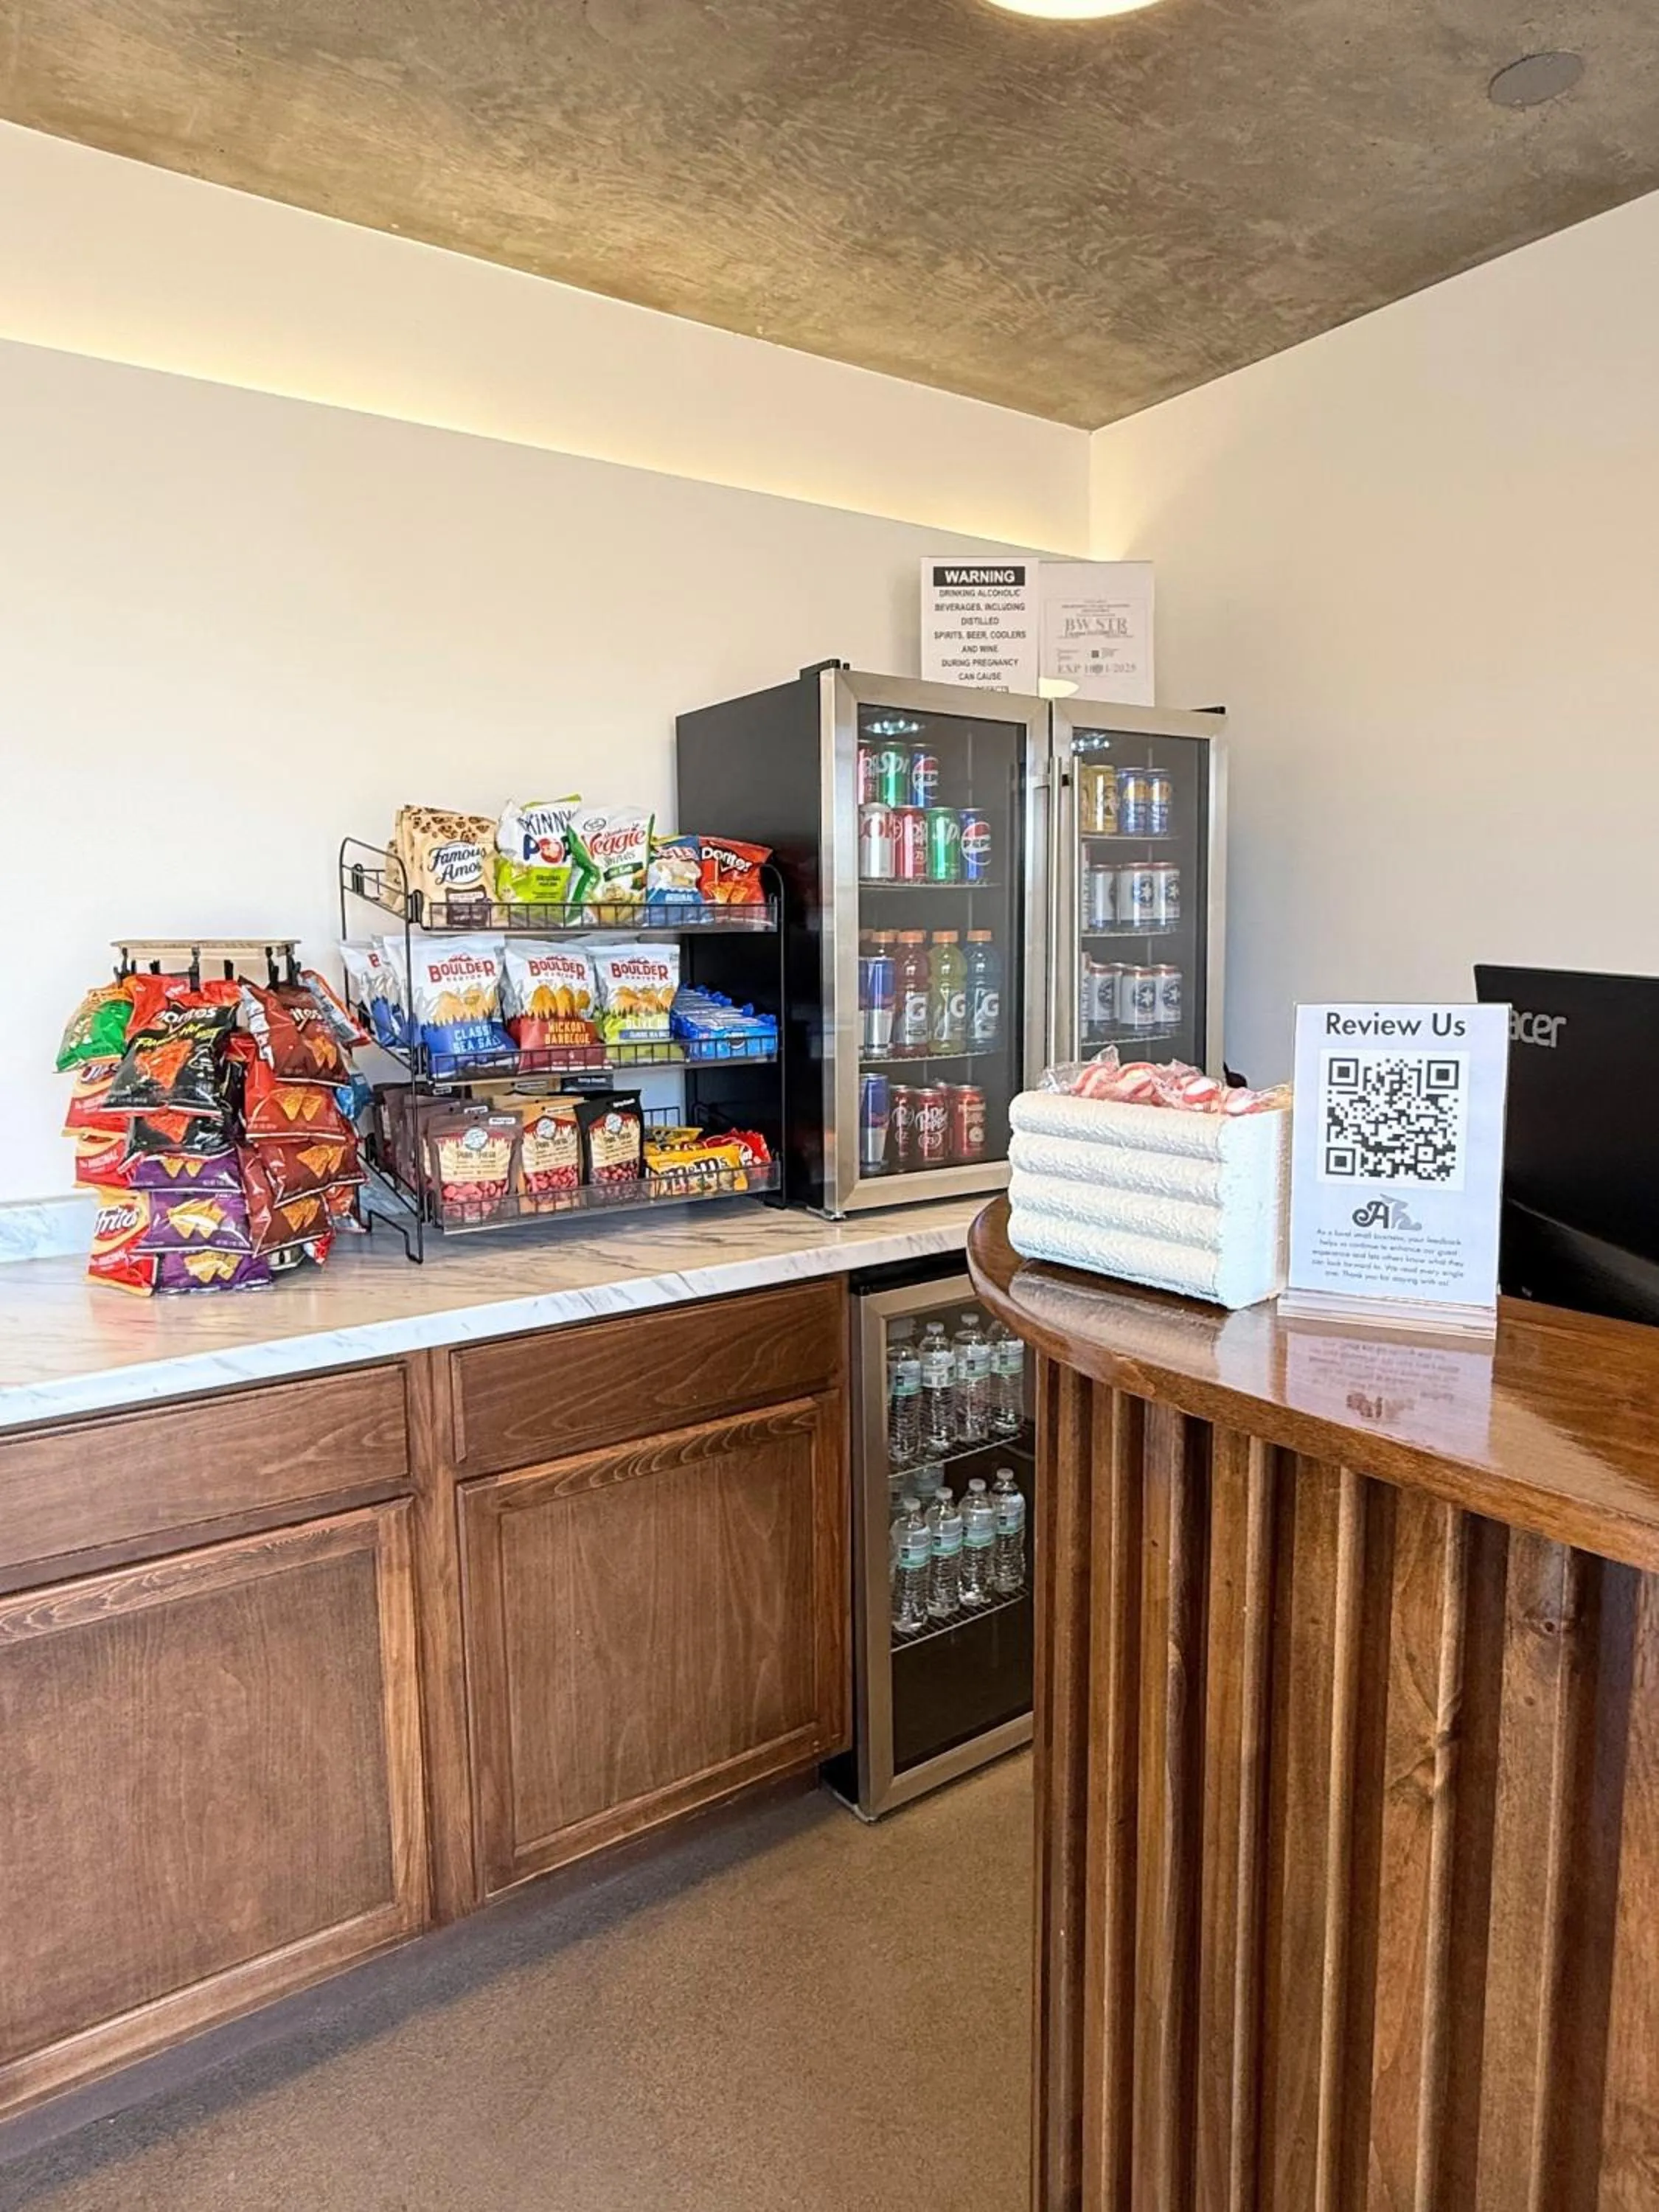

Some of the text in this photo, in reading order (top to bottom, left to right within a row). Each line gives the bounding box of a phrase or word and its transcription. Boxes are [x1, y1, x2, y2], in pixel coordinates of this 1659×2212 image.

[945, 570, 1015, 583] WARNING
[939, 589, 1020, 597] DRINKING ALCOHOLIC
[985, 603, 1026, 611] INCLUDING
[961, 616, 999, 625] DISTILLED
[990, 630, 1026, 639] COOLERS
[942, 658, 1018, 667] DURING PREGNANCY
[959, 672, 1001, 681] CAN CAUSE
[581, 830, 645, 860] Veggie
[428, 847, 487, 872] Famous
[428, 960, 495, 983] BOULDER
[528, 960, 585, 981] BOULDER
[611, 962, 669, 981] BOULDER
[548, 1020, 586, 1033] HICKORY
[1326, 1012, 1466, 1036] Review Us
